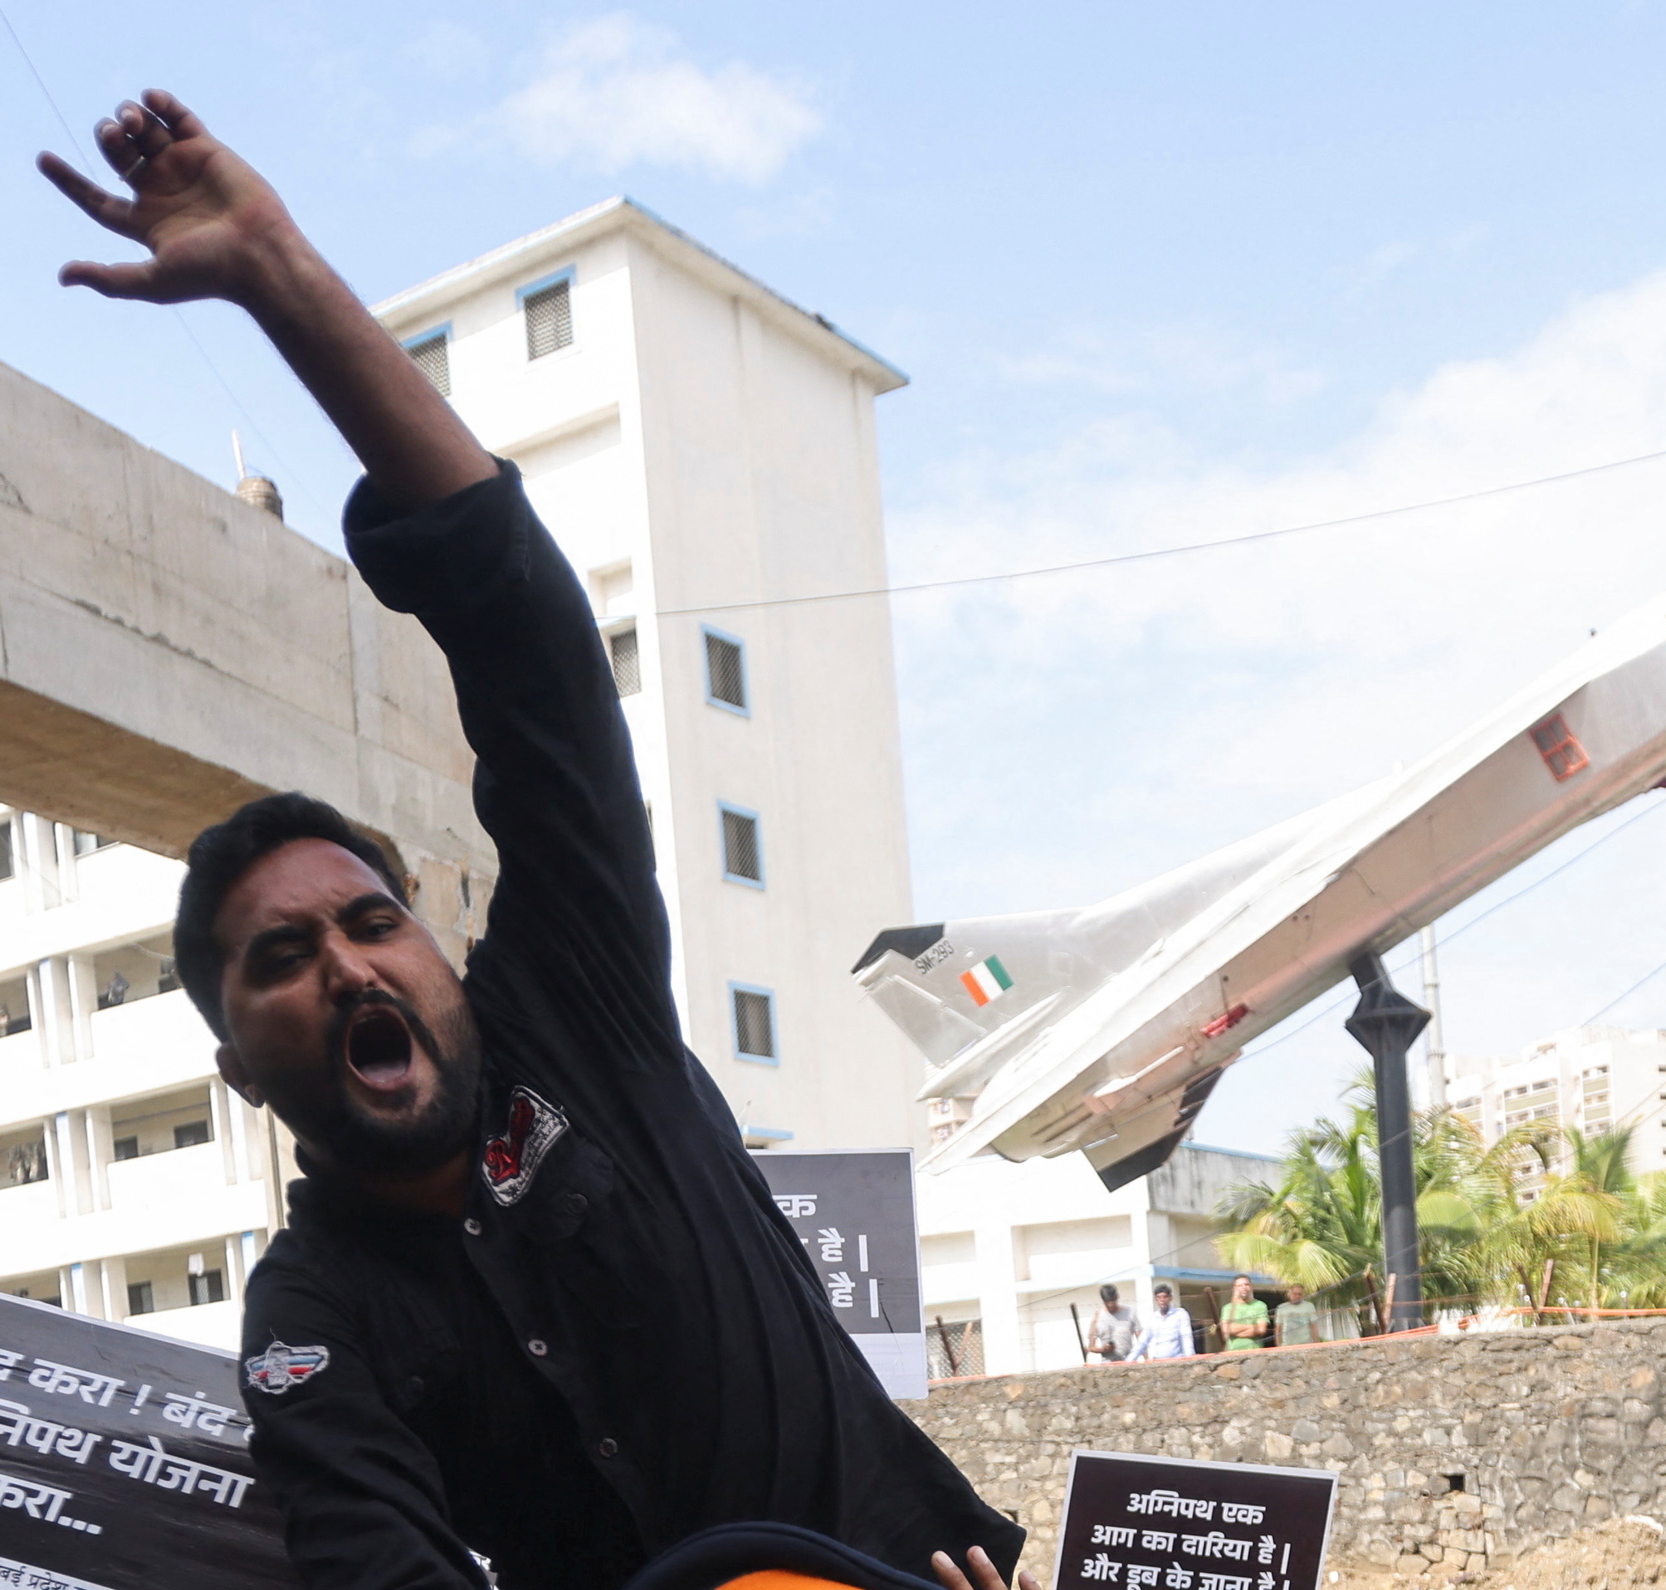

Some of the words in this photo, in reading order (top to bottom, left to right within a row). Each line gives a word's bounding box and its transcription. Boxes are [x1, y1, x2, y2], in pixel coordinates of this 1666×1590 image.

[28, 1358, 126, 1407] करा
[162, 1391, 237, 1437] बंद
[108, 1435, 256, 1509] योजना
[1126, 1489, 1217, 1521] अग्निपथ
[1221, 1502, 1266, 1525] एक
[1090, 1524, 1137, 1548] आग
[1141, 1530, 1177, 1553] का
[1080, 1553, 1122, 1582] और
[1165, 1561, 1194, 1590] के
